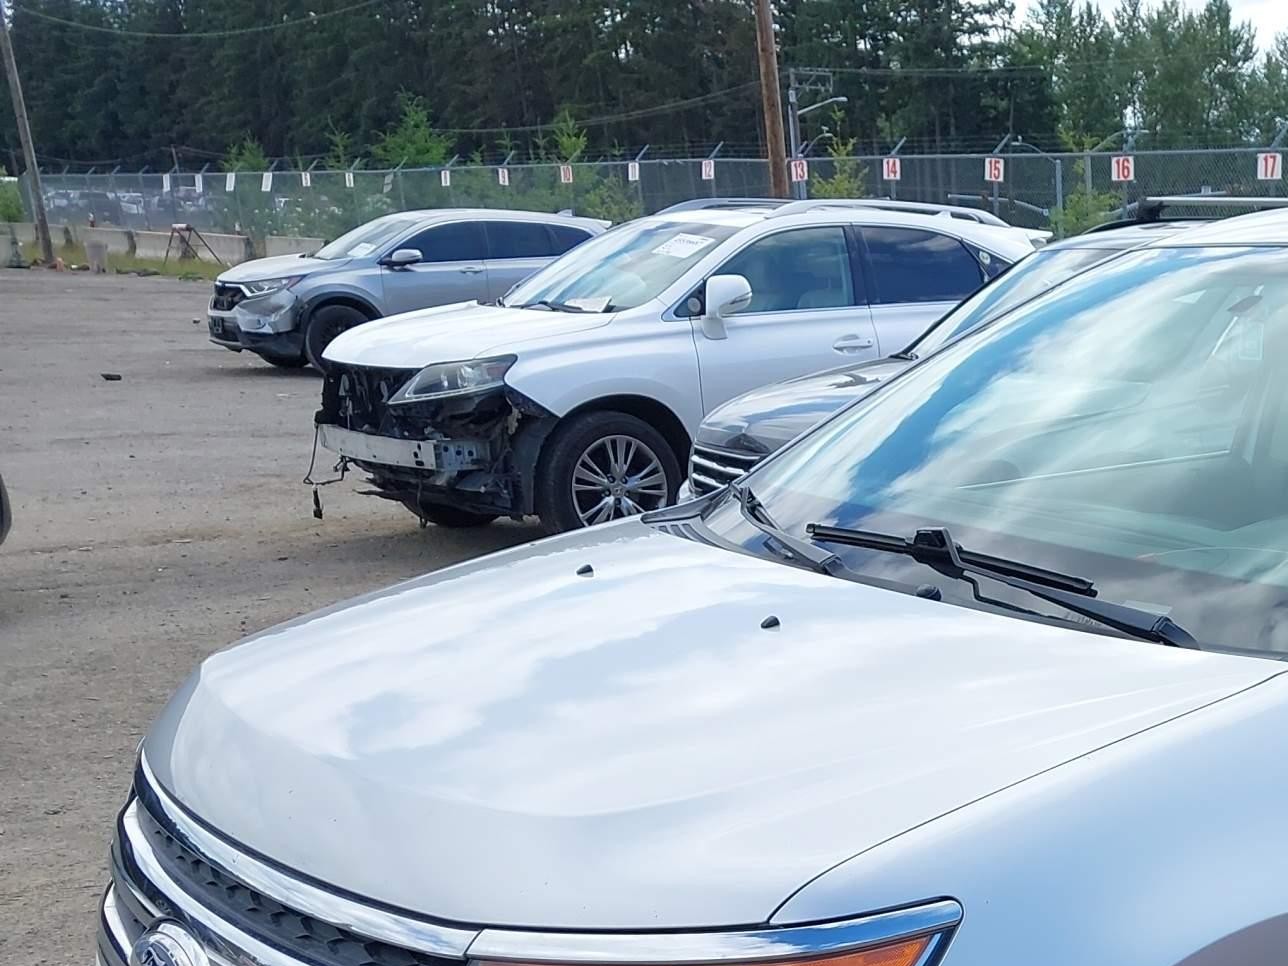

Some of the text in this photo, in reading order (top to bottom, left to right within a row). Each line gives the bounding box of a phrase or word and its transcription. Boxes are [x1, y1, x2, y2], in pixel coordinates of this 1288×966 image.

[793, 161, 806, 180] 13
[886, 159, 898, 179] 14
[988, 158, 1001, 179] 15
[1115, 158, 1130, 179] 16
[1263, 154, 1277, 178] 17
